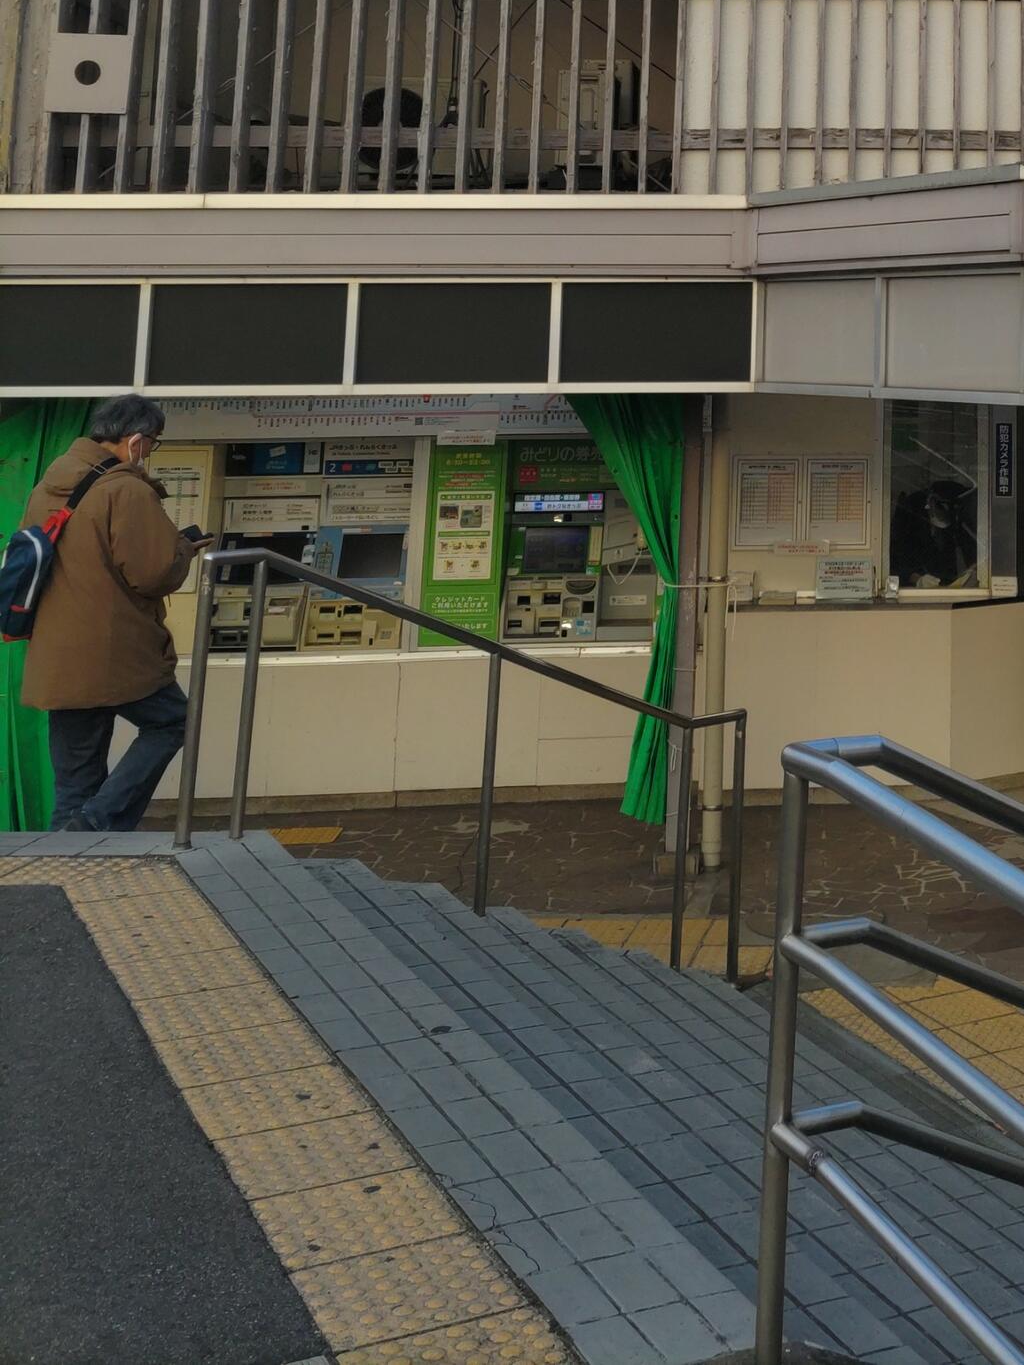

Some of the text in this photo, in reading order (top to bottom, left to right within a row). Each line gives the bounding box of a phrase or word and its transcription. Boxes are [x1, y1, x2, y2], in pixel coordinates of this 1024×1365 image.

[329, 463, 336, 473] 2
[999, 424, 1010, 496] 防犯カメラ作動中
